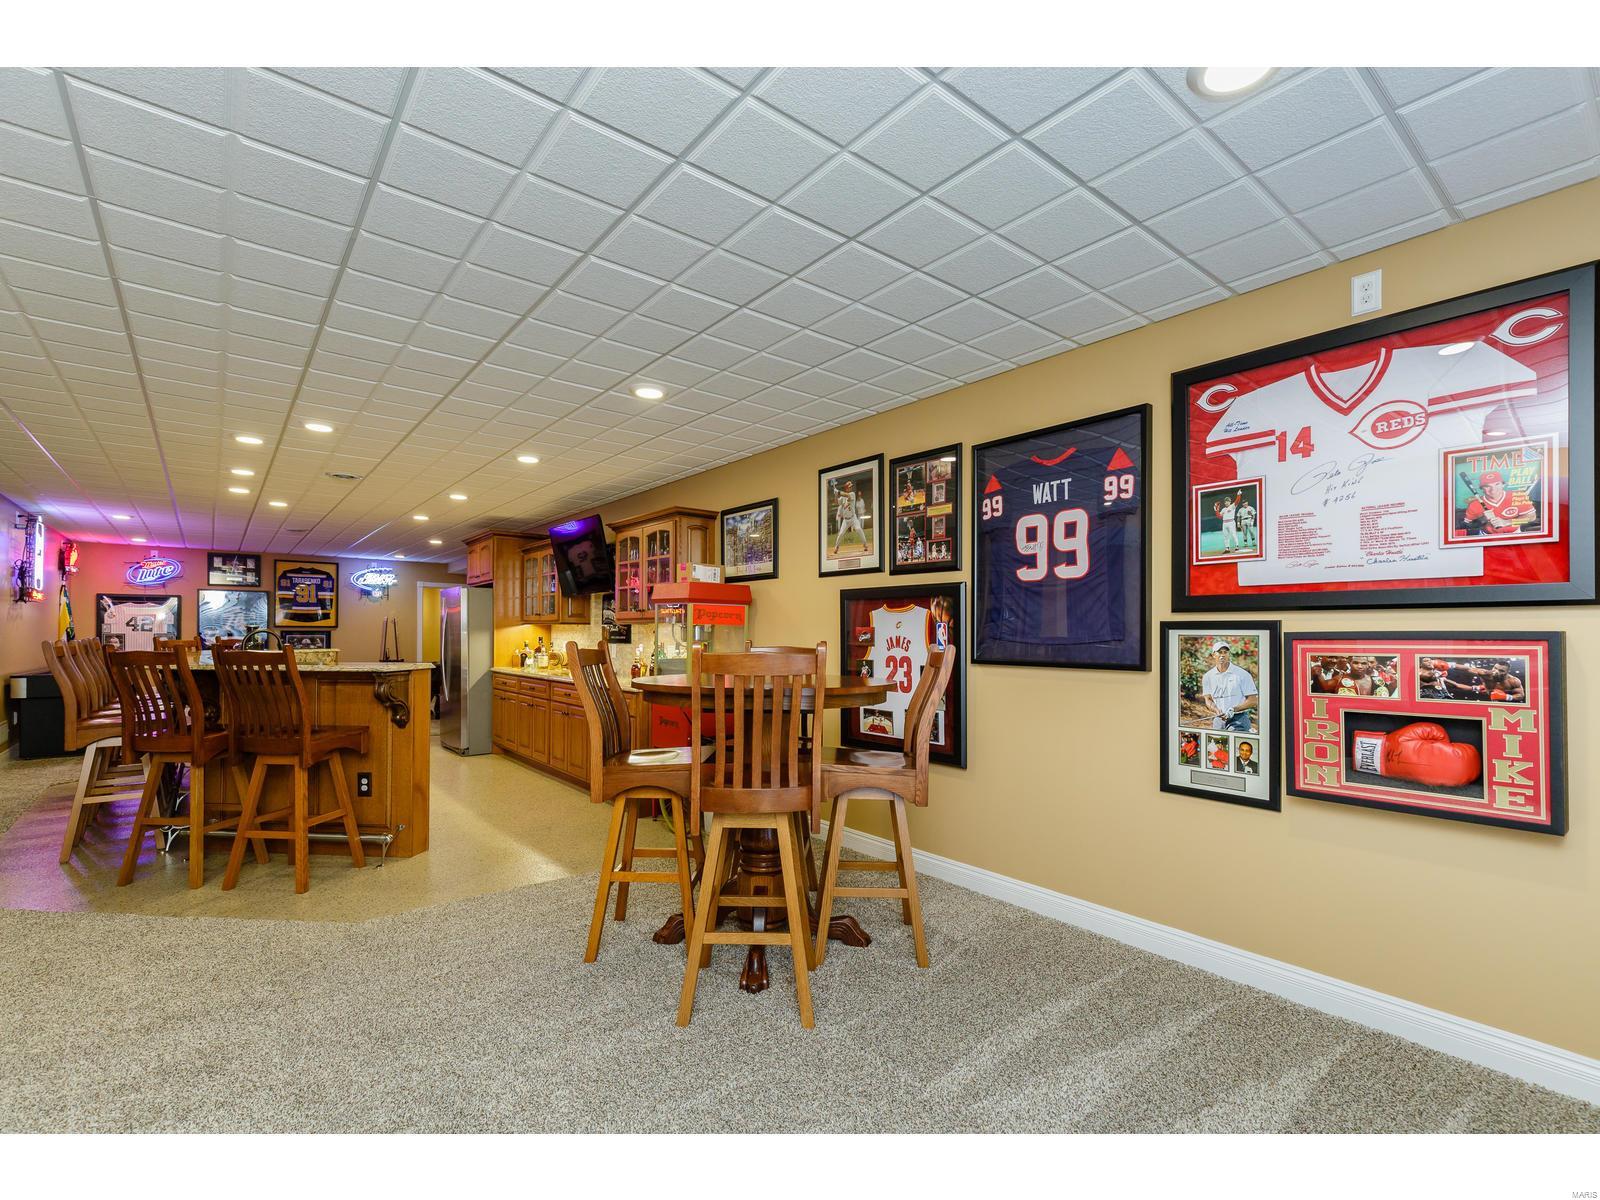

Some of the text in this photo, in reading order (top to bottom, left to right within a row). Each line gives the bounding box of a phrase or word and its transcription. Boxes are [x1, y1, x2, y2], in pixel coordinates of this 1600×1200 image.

[1375, 411, 1427, 434] REDS
[1276, 425, 1315, 463] 14
[1466, 448, 1526, 474] TIME
[1032, 477, 1072, 504] WATT
[1103, 474, 1135, 500] 99
[982, 495, 1003, 521] 99
[1016, 508, 1091, 582] 99
[296, 584, 317, 603] 91
[126, 616, 154, 632] 42
[696, 608, 743, 622] Popcorn
[886, 635, 912, 652] JAMES
[885, 655, 913, 694] 23
[1303, 697, 1340, 787] IRON
[1359, 740, 1378, 773] EVERLAST
[1488, 707, 1538, 812] MIKE
